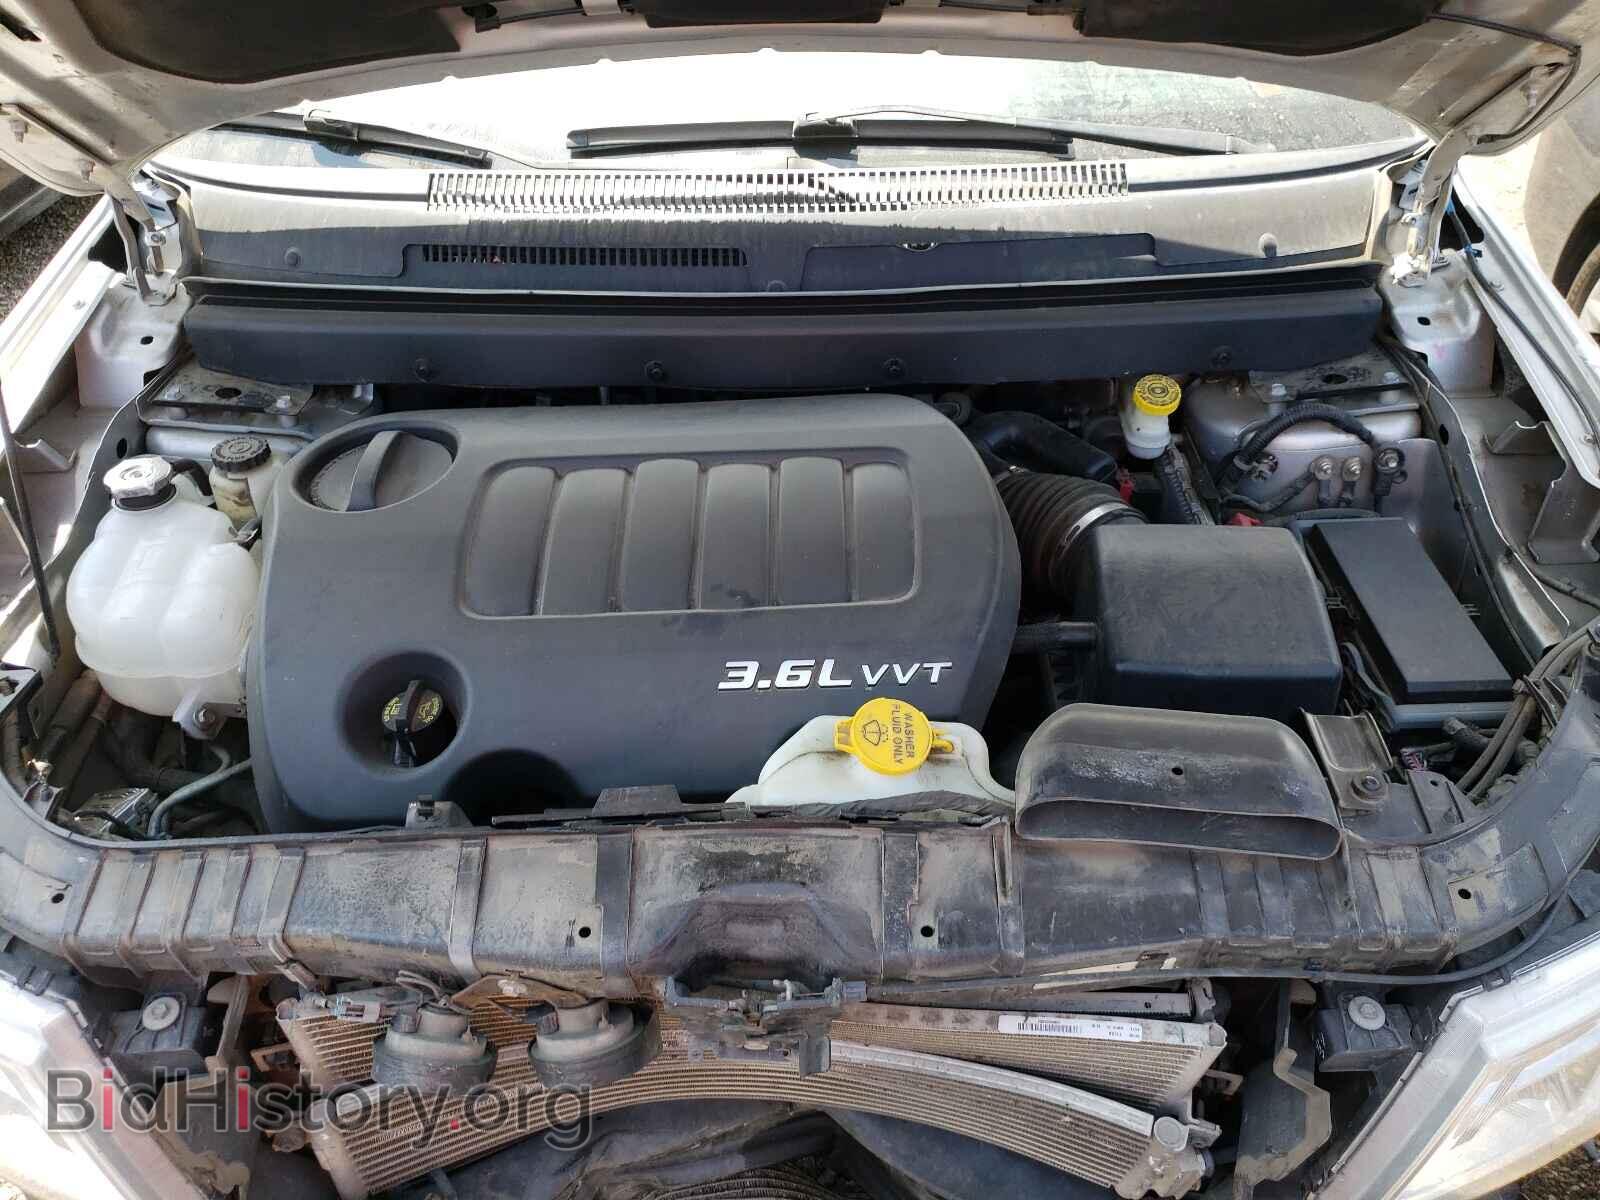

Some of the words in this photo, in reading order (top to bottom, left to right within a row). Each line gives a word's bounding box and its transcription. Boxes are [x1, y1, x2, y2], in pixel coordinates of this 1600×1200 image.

[718, 659, 853, 691] 3.6L
[861, 662, 953, 687] VVT
[891, 704, 902, 734] FLUID
[892, 736, 904, 765] ONLY
[903, 712, 915, 758] WASHER
